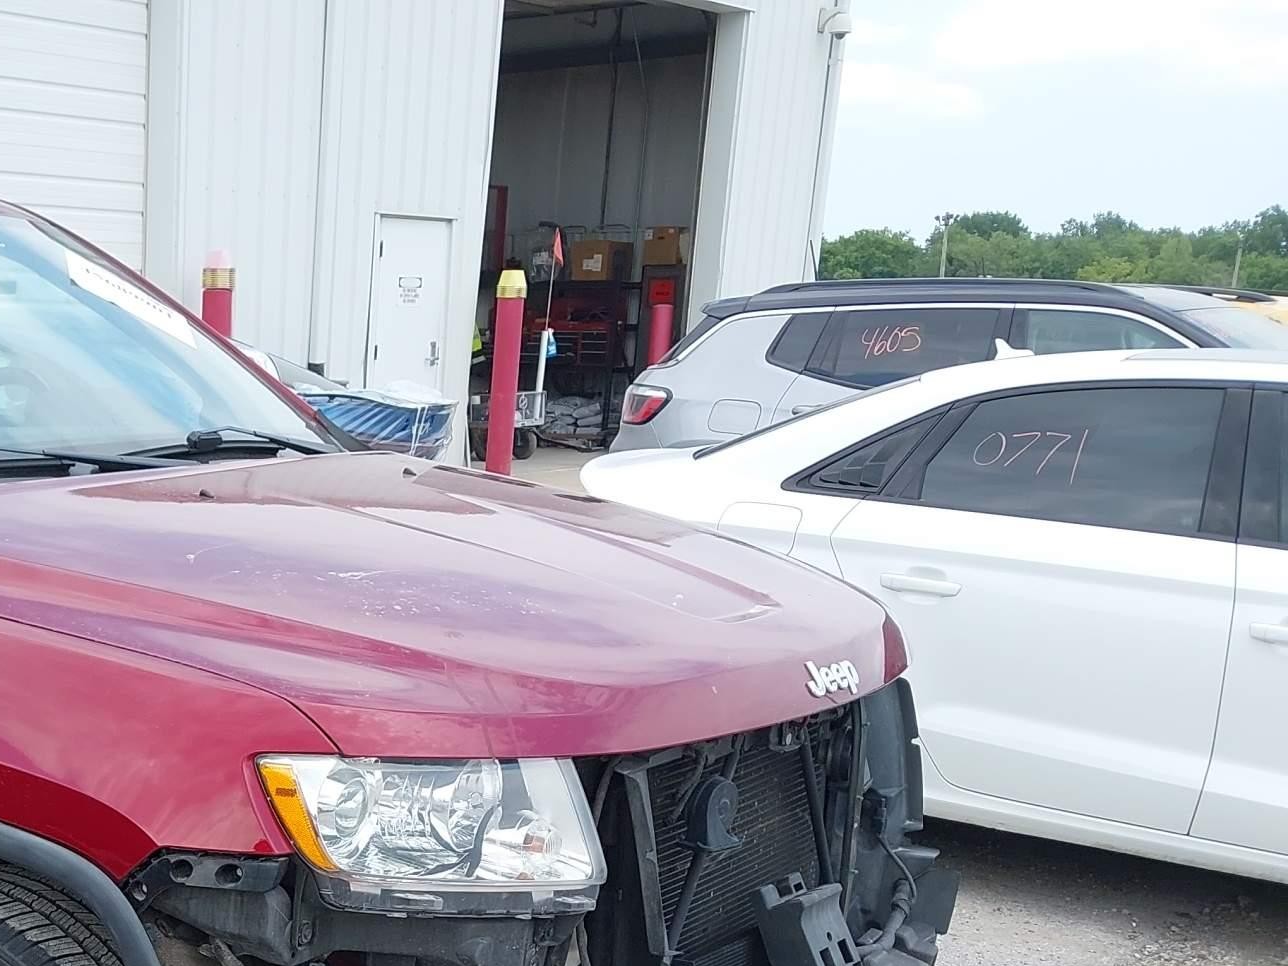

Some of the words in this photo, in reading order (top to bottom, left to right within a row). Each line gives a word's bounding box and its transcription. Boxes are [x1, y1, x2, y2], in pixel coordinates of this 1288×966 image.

[861, 325, 921, 359] 4605
[973, 429, 1089, 484] 0771
[803, 660, 859, 698] Jeep
